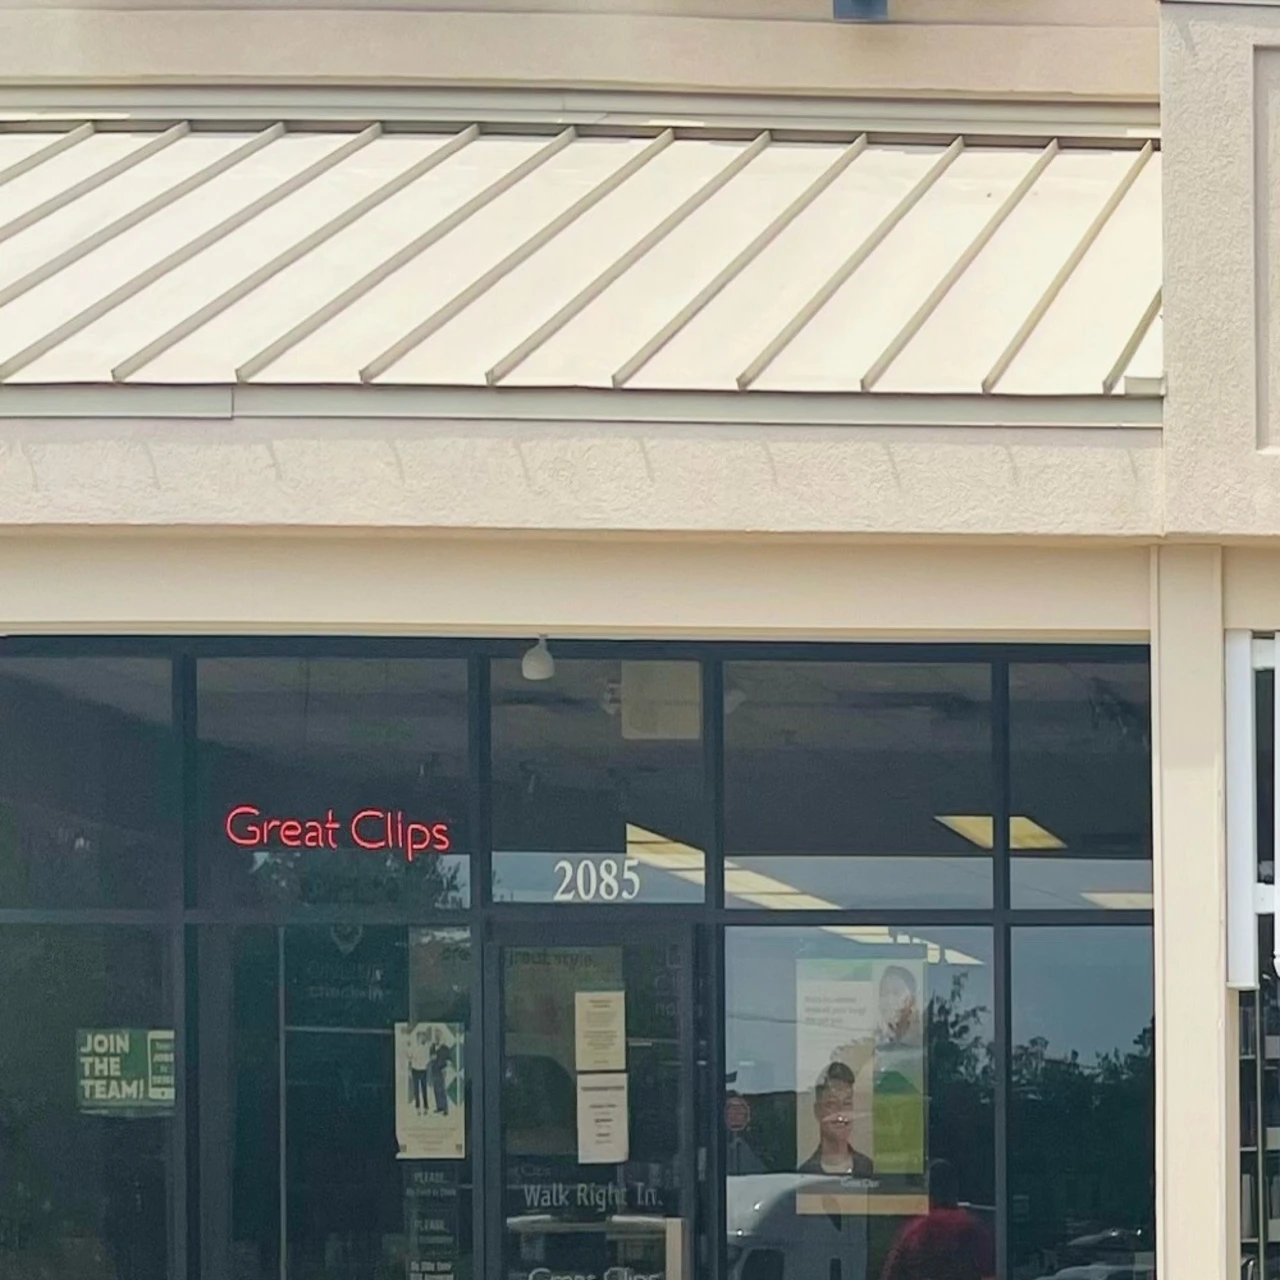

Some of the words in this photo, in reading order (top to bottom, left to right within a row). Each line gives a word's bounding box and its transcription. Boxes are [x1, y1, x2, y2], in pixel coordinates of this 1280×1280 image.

[225, 804, 340, 850] Great
[350, 809, 451, 862] Clips
[553, 859, 640, 901] 2085
[80, 1033, 130, 1054] JOIN
[80, 1055, 121, 1077] THE
[80, 1078, 145, 1099] TEAM!
[523, 1182, 570, 1207] Walk
[576, 1182, 628, 1212] Right
[636, 1181, 664, 1206] In.
